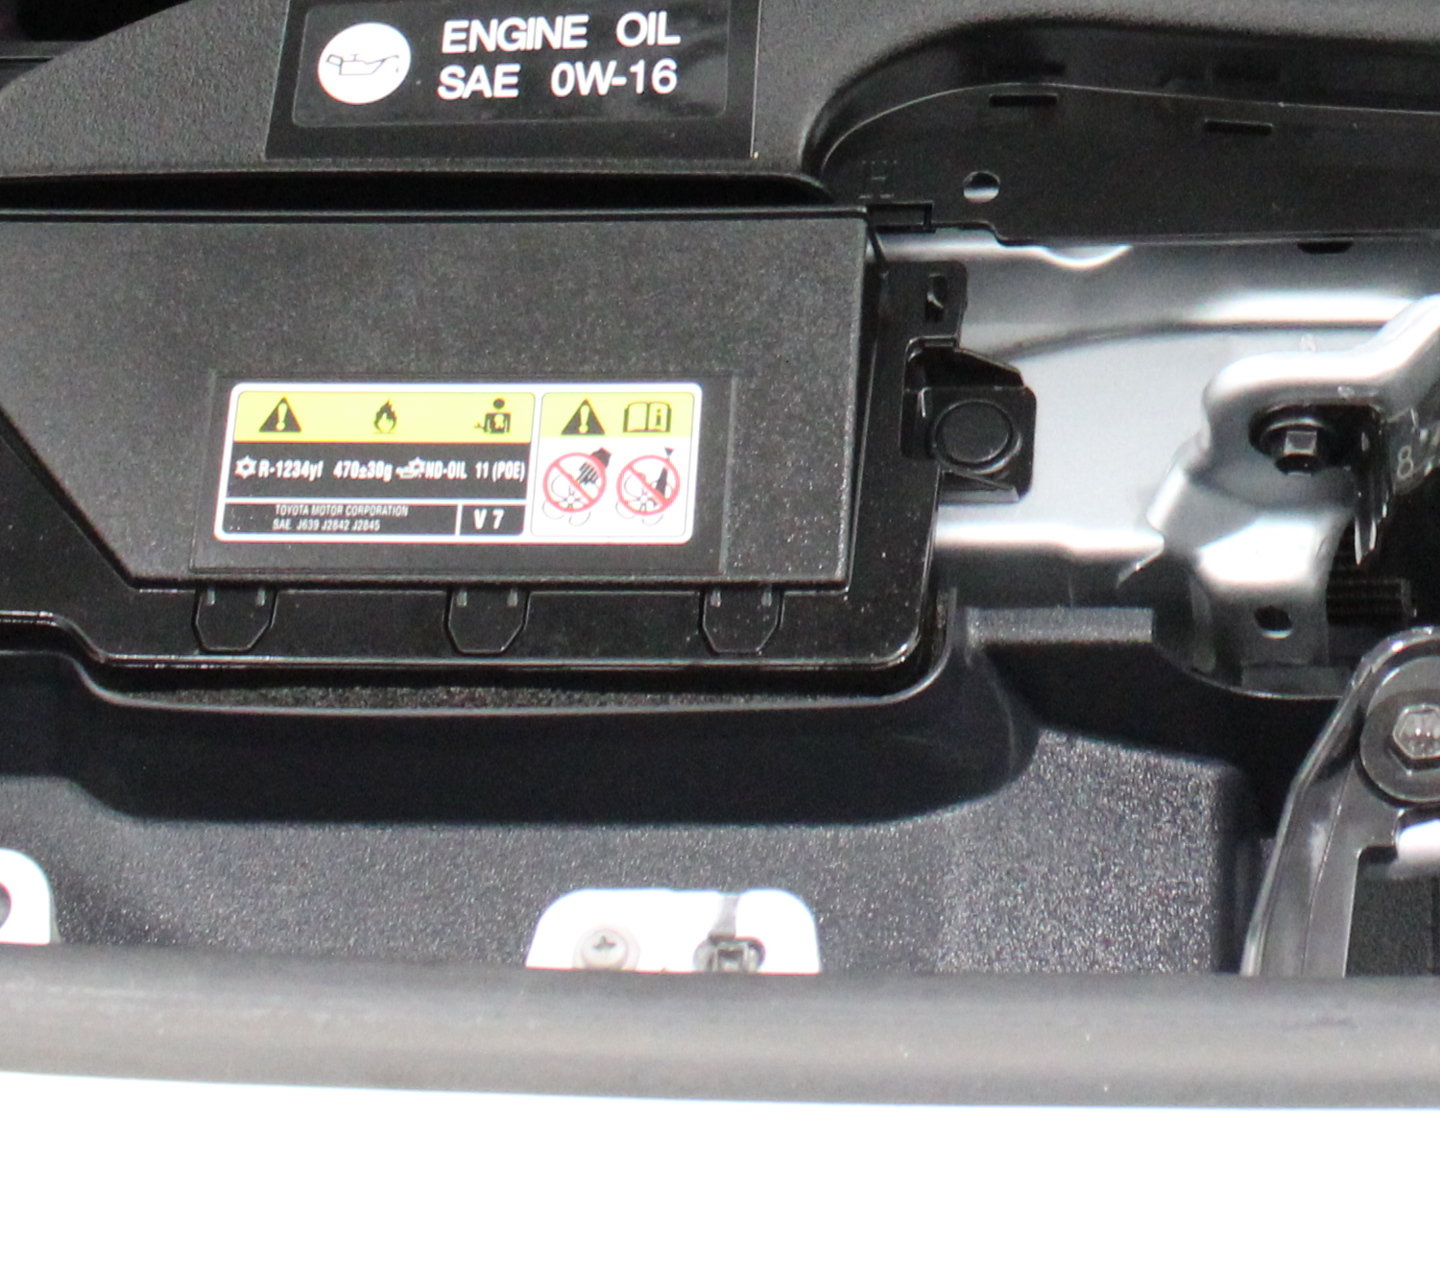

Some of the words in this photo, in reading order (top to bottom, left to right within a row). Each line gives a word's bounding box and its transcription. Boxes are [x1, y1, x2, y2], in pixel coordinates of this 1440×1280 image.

[441, 14, 589, 53] ENGINE
[616, 10, 681, 47] OIL
[437, 63, 521, 100] SAE
[550, 58, 678, 97] 0W-16
[257, 459, 323, 482] R-1234yf
[333, 460, 393, 482] 470±30g
[424, 460, 467, 479] ND-OIL
[475, 461, 488, 479] 11
[491, 461, 526, 483] (POE)
[275, 504, 309, 516] TOYOTA
[311, 504, 344, 516] MOTOR
[345, 504, 409, 517] CORPORATION
[473, 509, 488, 530] V
[491, 509, 505, 529] 7
[272, 520, 292, 531] SAE
[296, 520, 320, 532] J639
